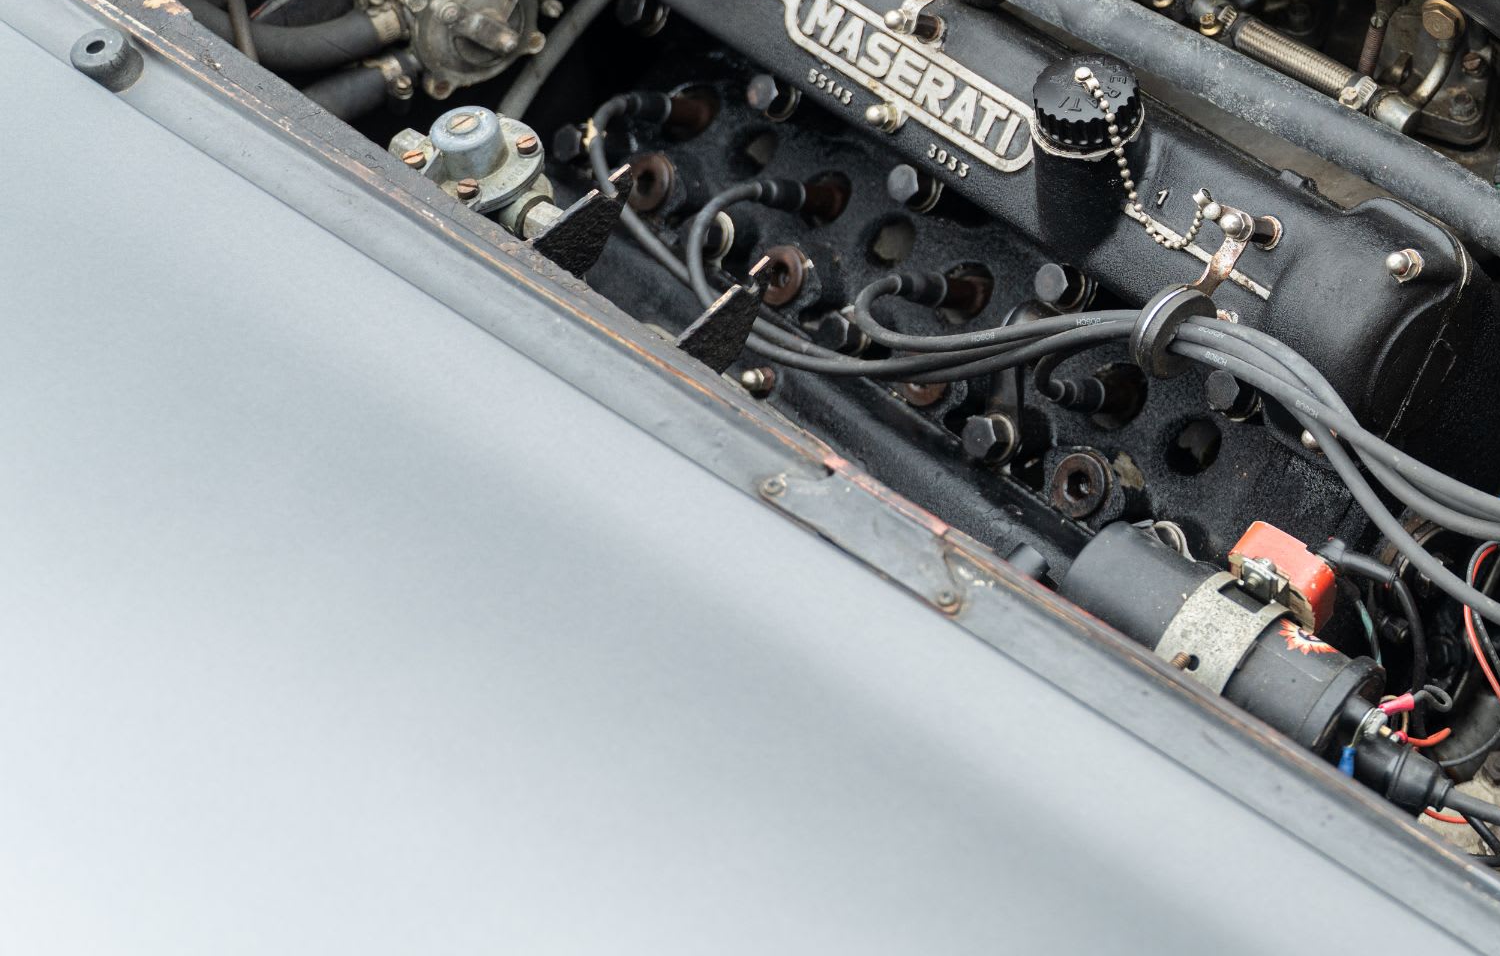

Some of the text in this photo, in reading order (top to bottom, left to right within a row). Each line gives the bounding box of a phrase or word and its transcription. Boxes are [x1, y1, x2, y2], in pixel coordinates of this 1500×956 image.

[808, 67, 854, 105] 55143
[927, 143, 969, 178] 3033
[1204, 350, 1228, 366] BOSCH
[1295, 399, 1319, 418] BOSCH
